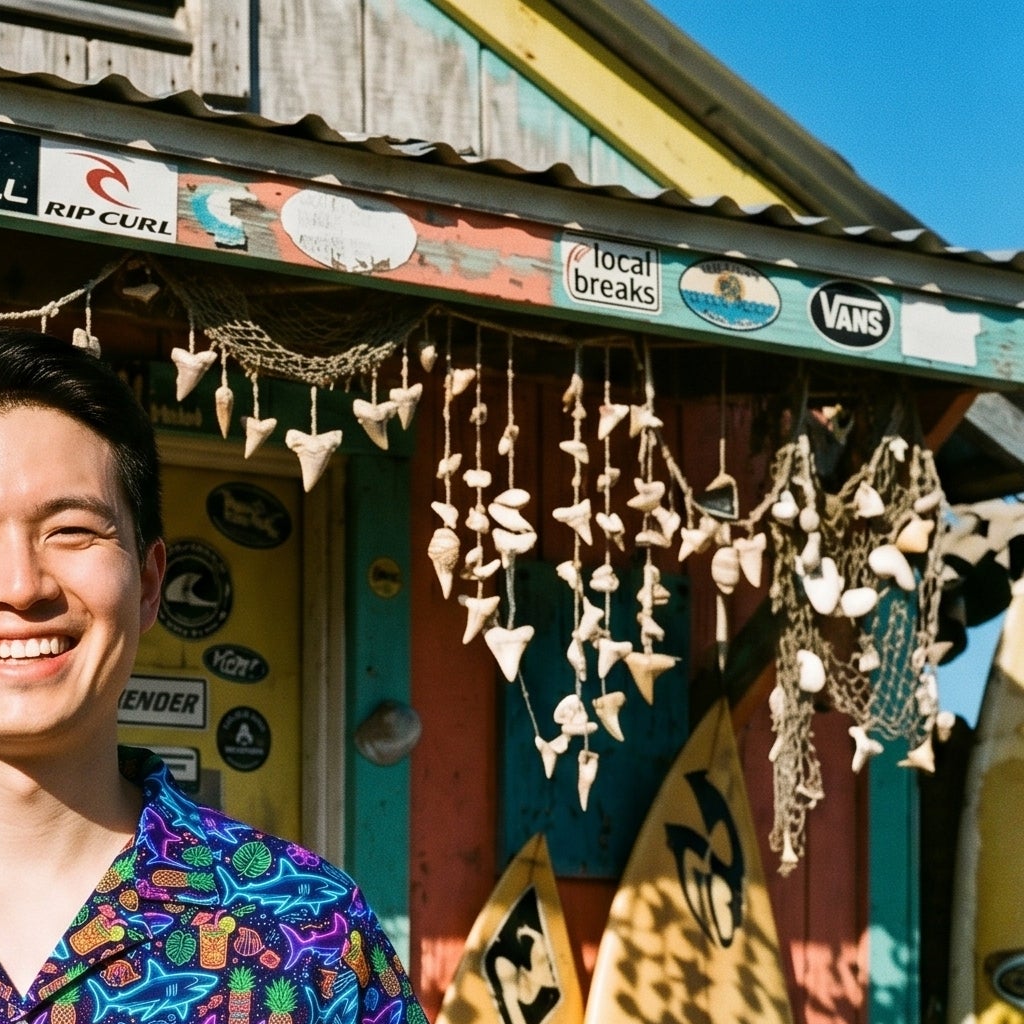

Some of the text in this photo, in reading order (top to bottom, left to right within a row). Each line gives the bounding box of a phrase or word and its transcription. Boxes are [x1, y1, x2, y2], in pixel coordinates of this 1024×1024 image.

[45, 201, 173, 235] RIP CURL
[594, 243, 651, 277] local
[574, 268, 655, 305] breaks
[819, 290, 884, 337] VANS
[117, 689, 201, 715] ENDER
